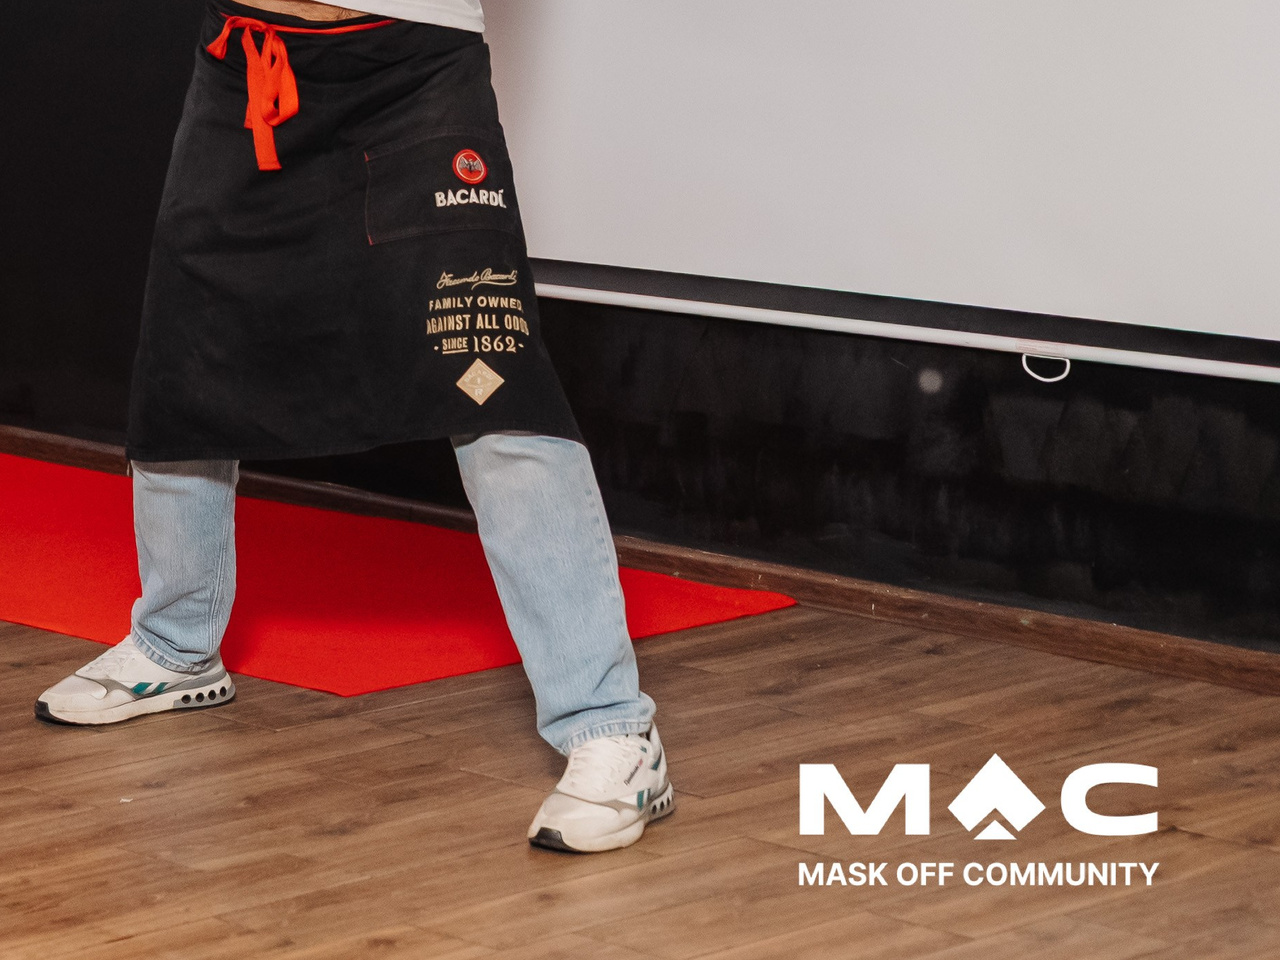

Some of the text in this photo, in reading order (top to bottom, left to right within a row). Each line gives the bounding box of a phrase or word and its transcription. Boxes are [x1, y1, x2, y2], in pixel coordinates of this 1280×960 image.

[428, 296, 474, 312] FAMILY
[426, 314, 471, 335] AGAINST
[476, 313, 500, 330] ALL
[442, 334, 517, 353] SINCE 1862
